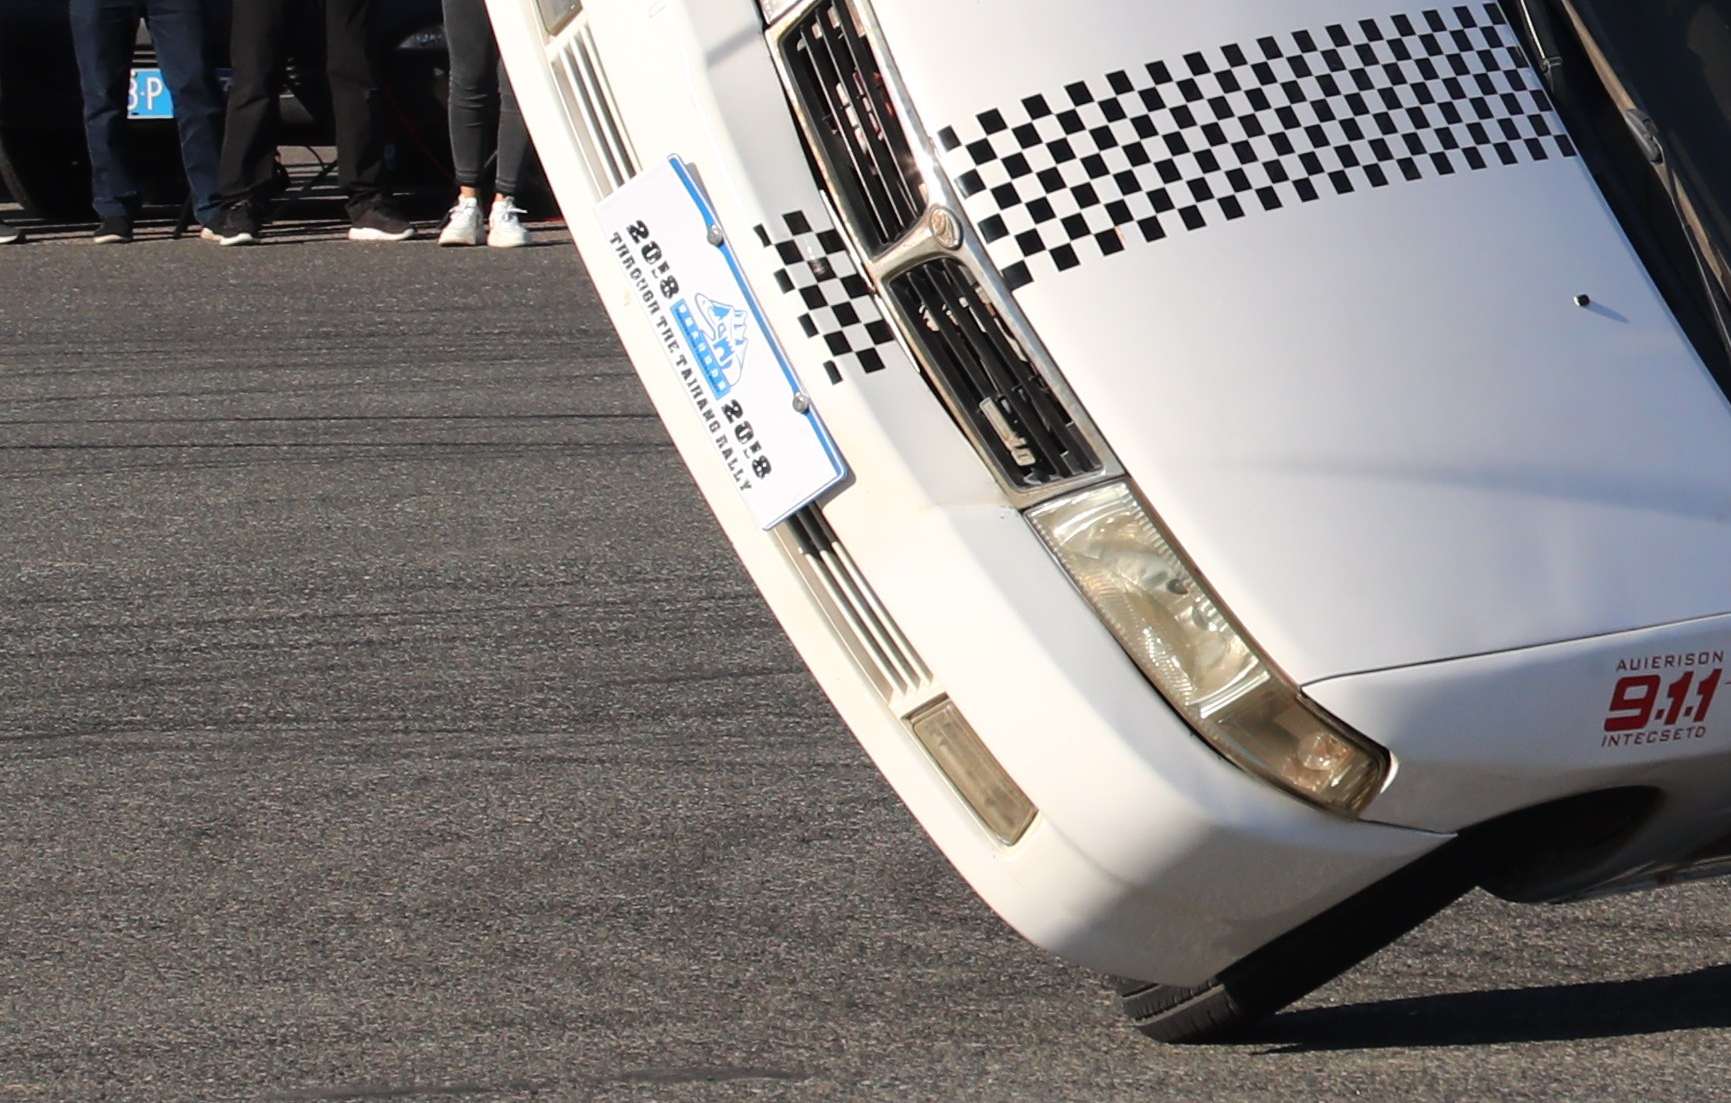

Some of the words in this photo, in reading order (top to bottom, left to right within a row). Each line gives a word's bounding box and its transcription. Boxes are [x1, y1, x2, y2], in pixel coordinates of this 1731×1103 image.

[655, 315, 680, 353] THE
[715, 432, 753, 492] RALLY
[1615, 650, 1724, 672] AUIERISON
